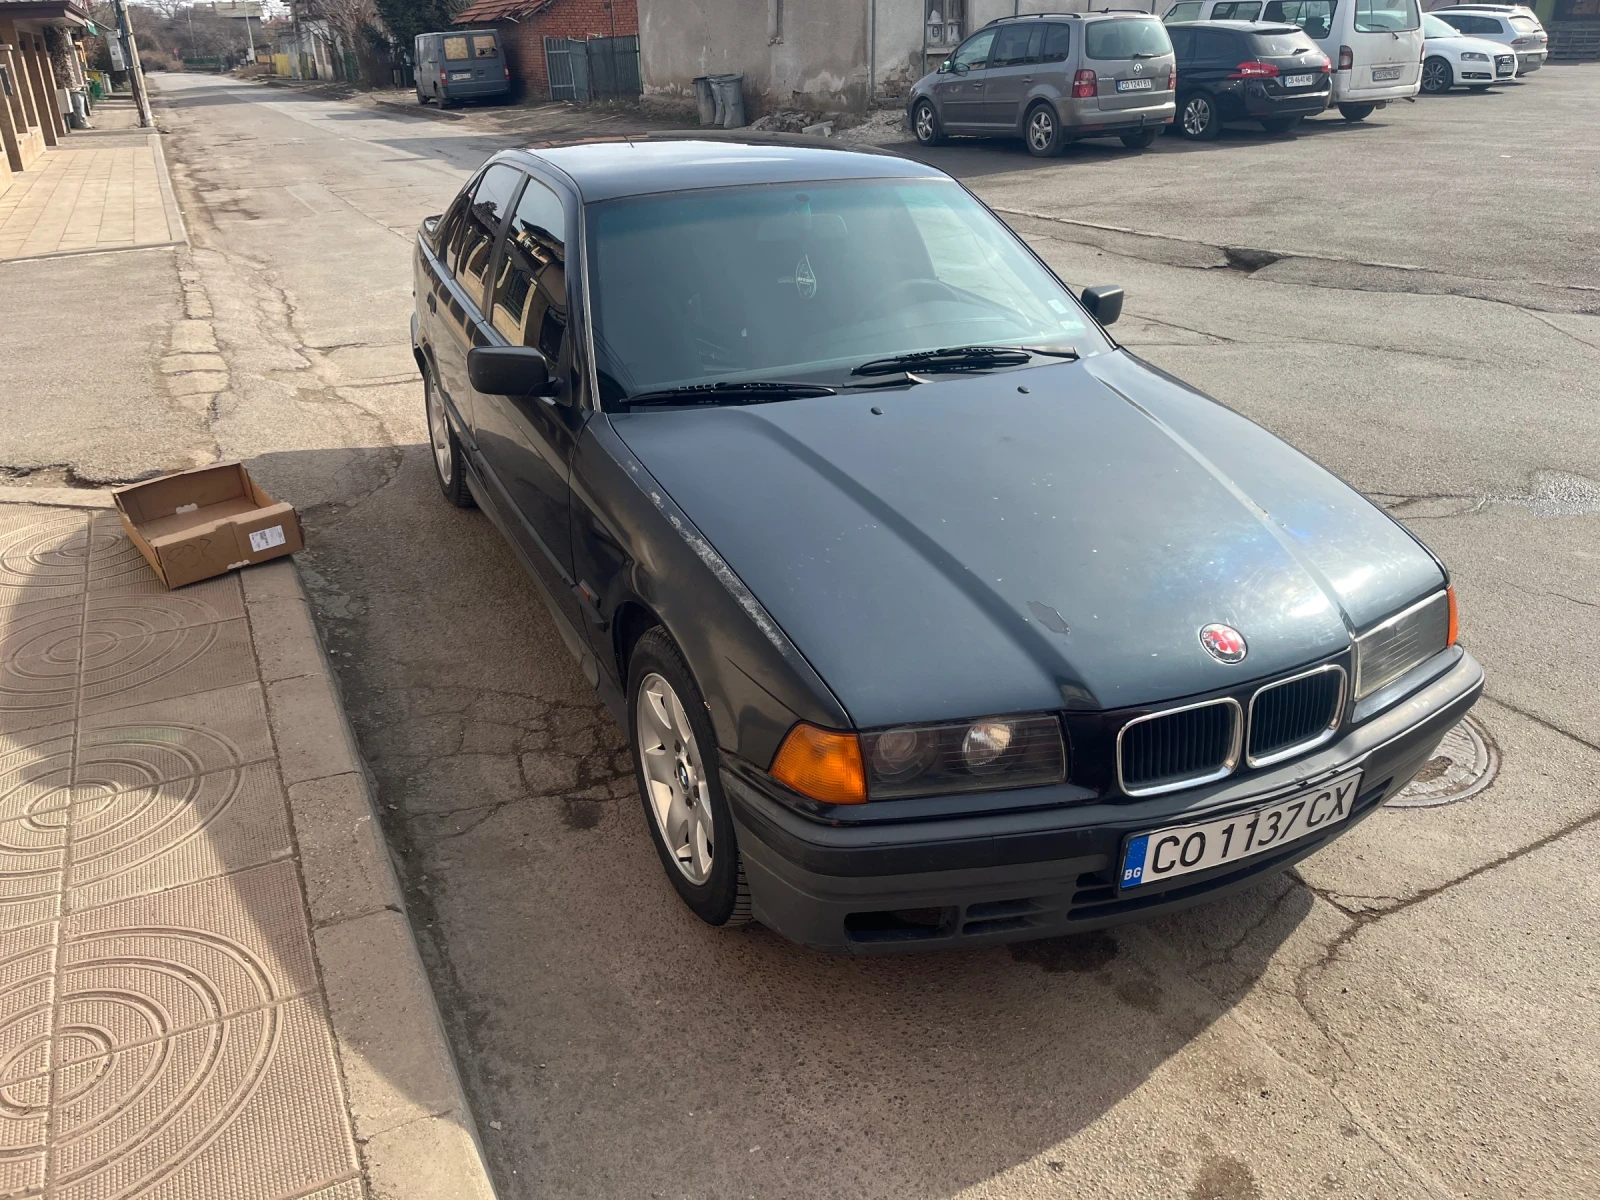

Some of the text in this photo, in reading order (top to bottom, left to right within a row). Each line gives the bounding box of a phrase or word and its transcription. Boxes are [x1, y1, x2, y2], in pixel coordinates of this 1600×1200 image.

[1130, 80, 1143, 88] 1241
[1151, 781, 1353, 874] CO 1137 CX
[1123, 868, 1142, 881] BG
